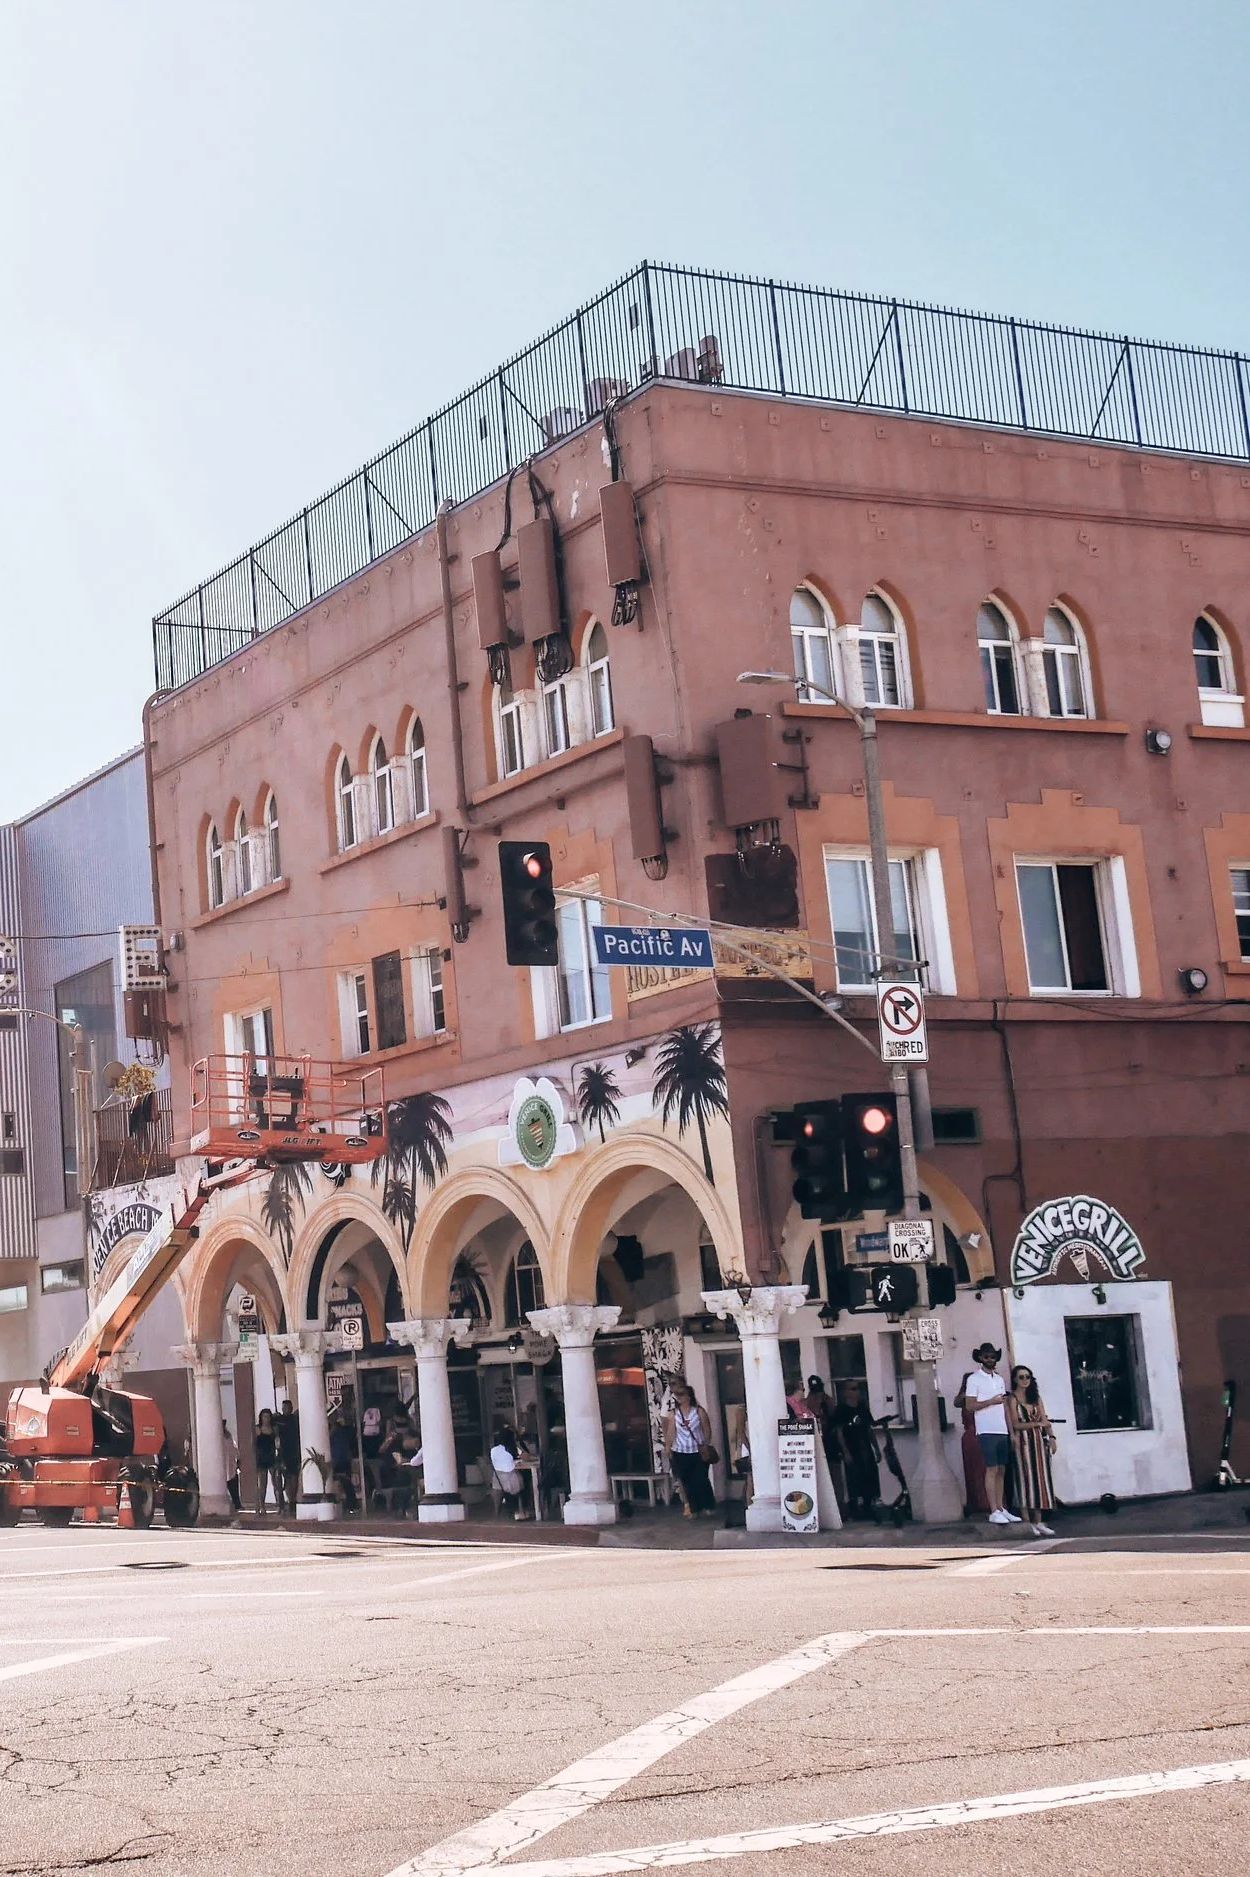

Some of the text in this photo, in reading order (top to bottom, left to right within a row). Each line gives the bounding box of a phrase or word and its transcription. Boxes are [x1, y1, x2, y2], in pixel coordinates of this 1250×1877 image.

[603, 934, 703, 957] Pacific Av
[904, 1041, 924, 1054] RED
[519, 1102, 553, 1128] VENICE GRILL
[118, 1207, 148, 1235] BEACH
[894, 1222, 925, 1230] DIAGONAL
[1015, 1201, 1139, 1278] VENICE GRILL
[893, 1243, 910, 1259] OK
[328, 1377, 343, 1390] ATM
